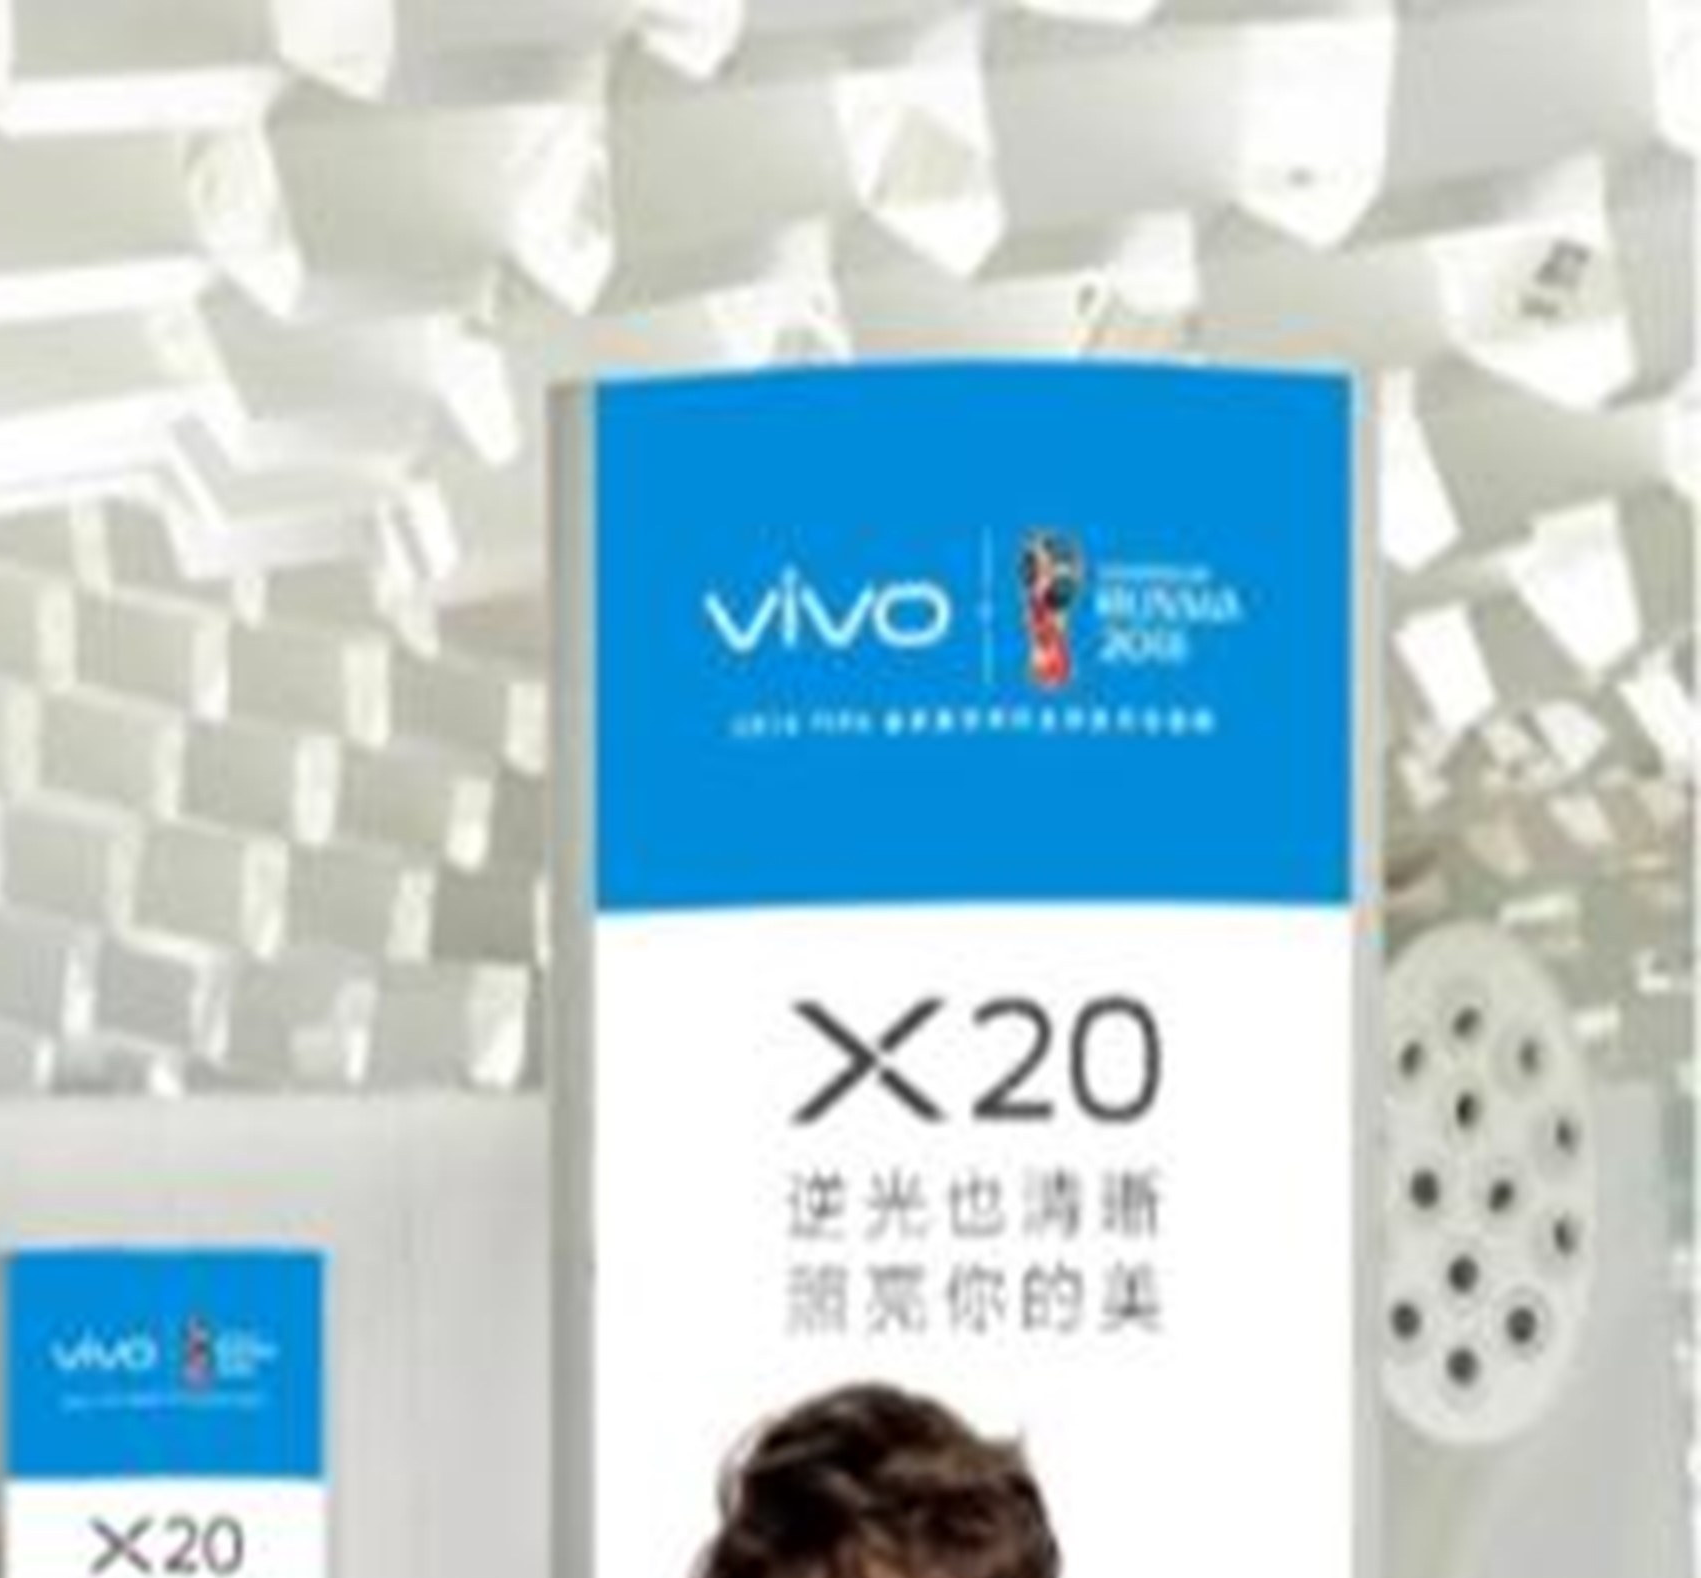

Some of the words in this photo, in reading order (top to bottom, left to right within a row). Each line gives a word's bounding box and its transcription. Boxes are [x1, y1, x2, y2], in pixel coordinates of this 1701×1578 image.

[703, 566, 953, 654] vivo
[793, 995, 1163, 1125] X20
[91, 1515, 245, 1577] X20
